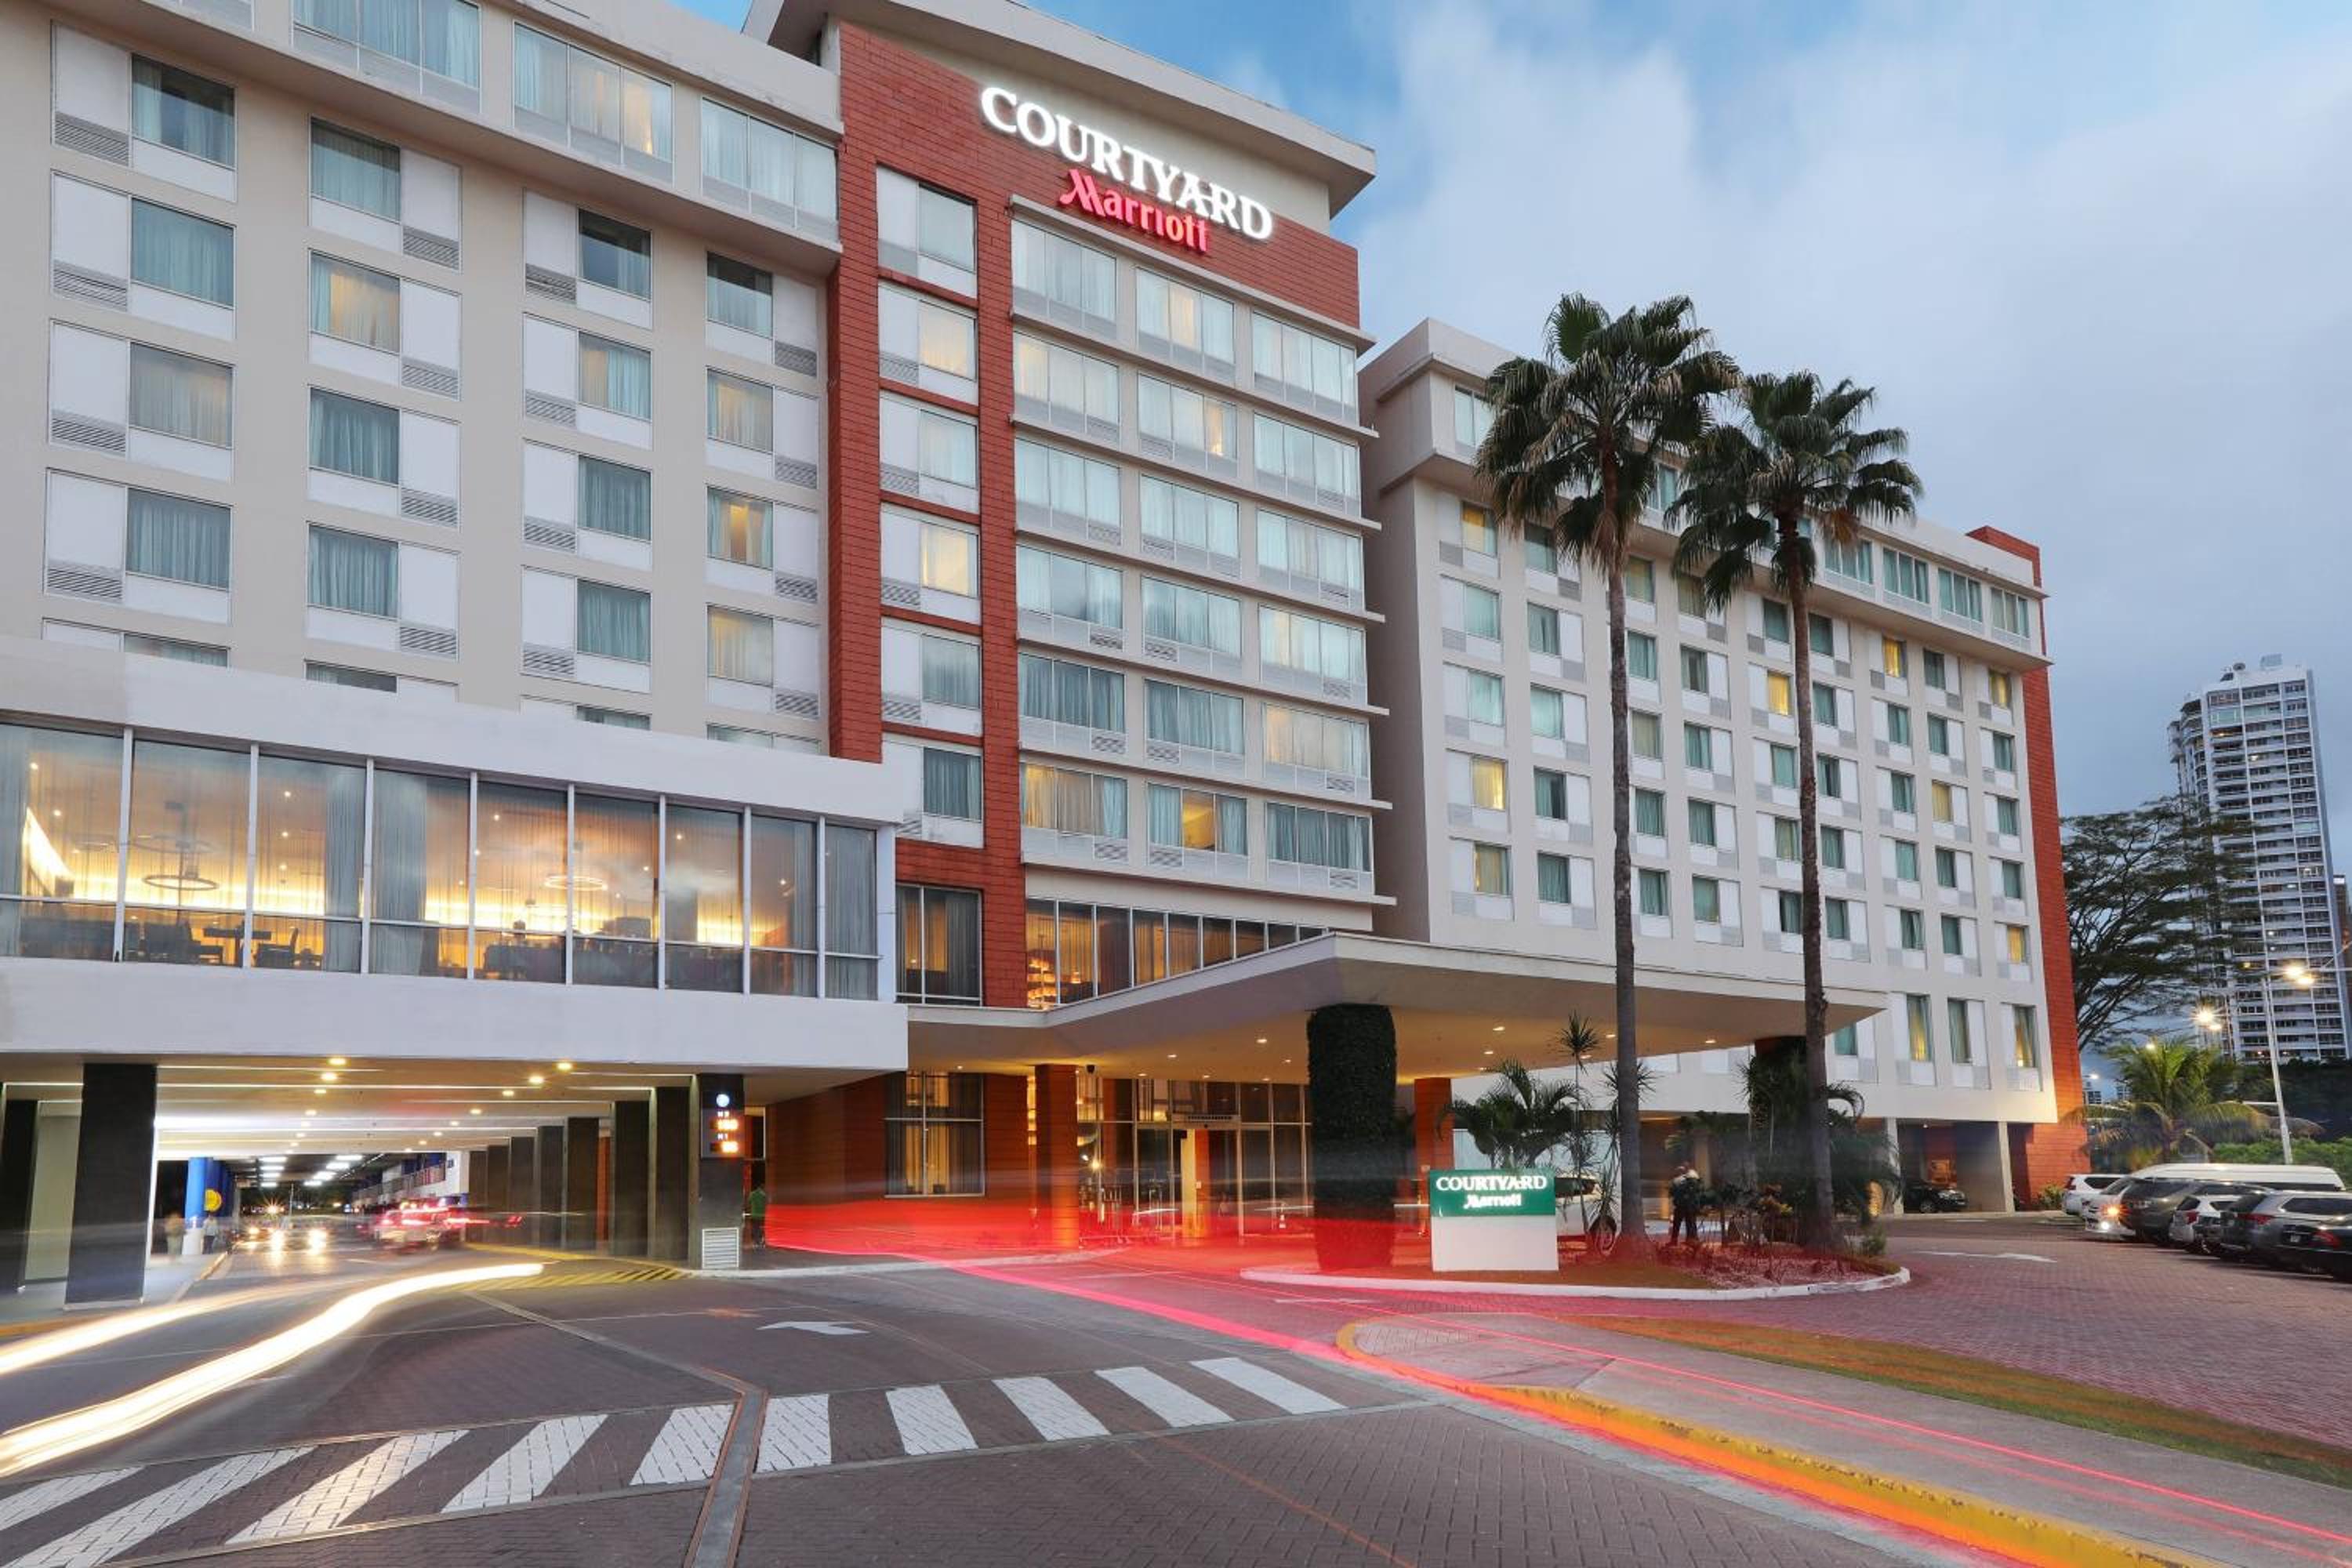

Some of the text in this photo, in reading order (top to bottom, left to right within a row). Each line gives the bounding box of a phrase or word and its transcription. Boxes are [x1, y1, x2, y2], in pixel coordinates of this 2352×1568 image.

[981, 86, 1273, 240] COURTYARD
[1059, 169, 1210, 252] Marriott
[1436, 1175, 1548, 1191] COURTYARD
